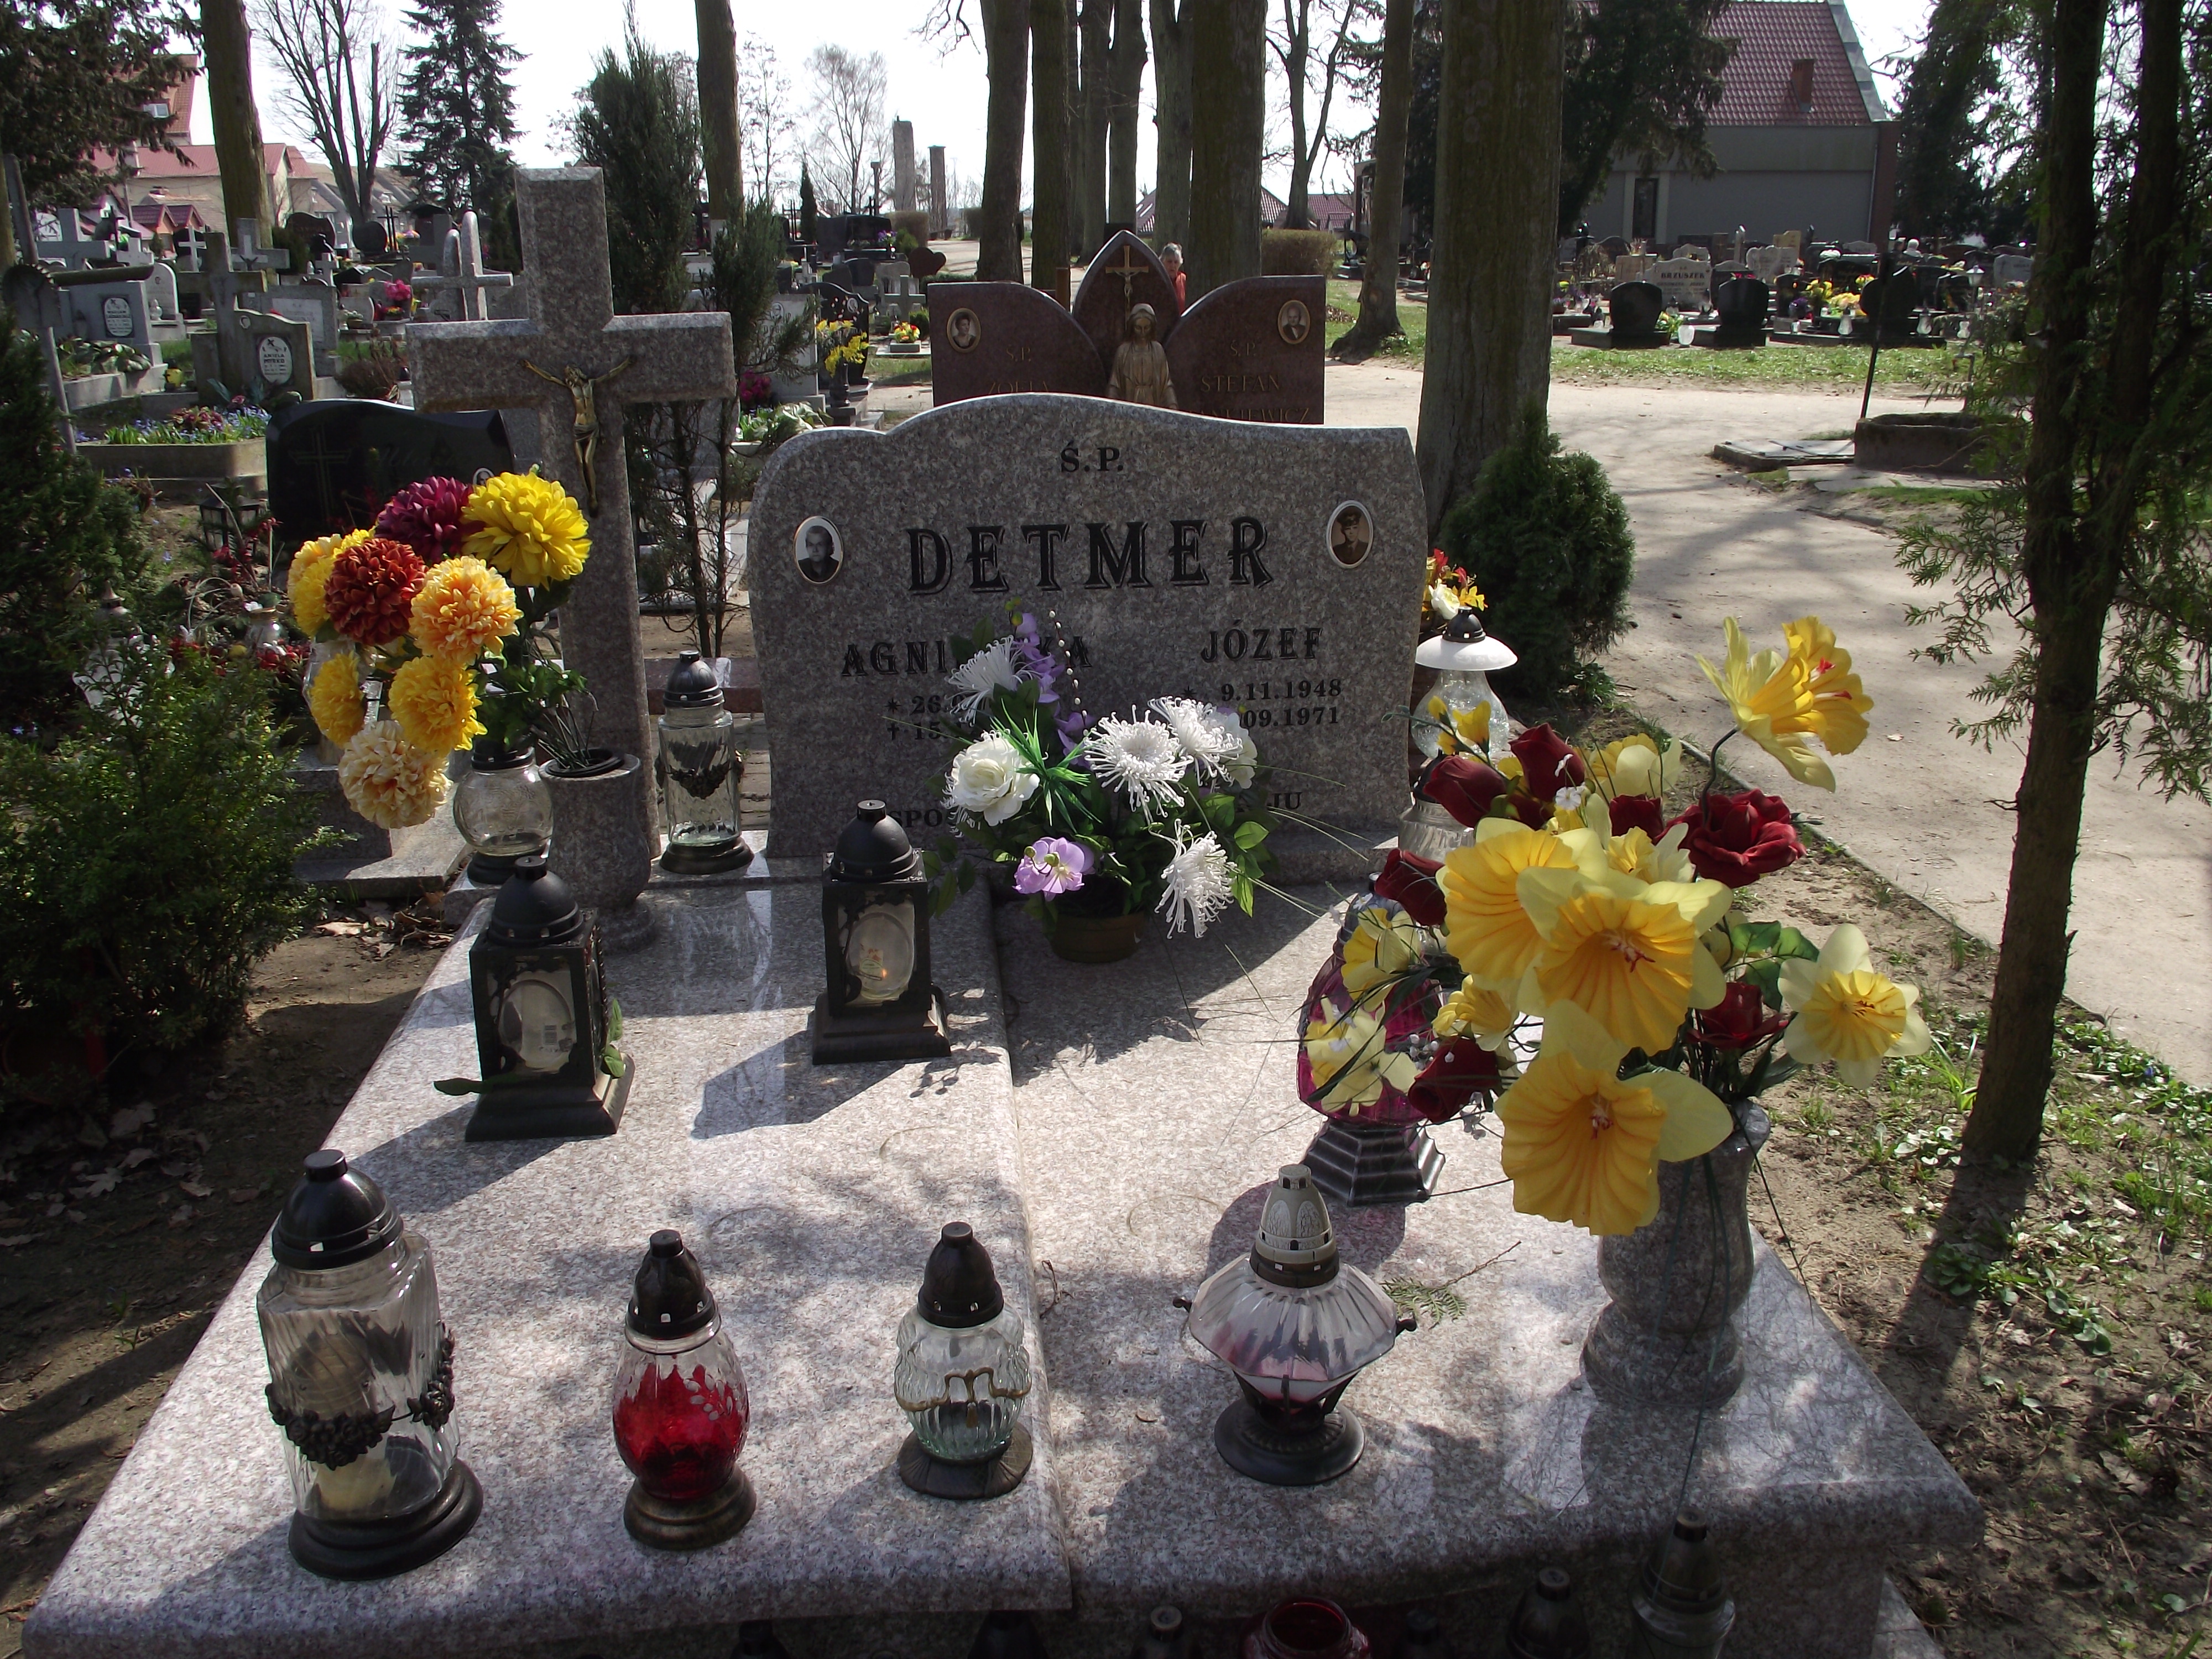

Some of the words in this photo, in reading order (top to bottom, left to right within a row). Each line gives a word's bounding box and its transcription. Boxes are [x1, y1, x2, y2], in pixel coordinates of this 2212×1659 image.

[1200, 374, 1280, 393] STEFAN
[1061, 441, 1124, 473] Ś.P.
[906, 515, 1273, 595] DETMER
[841, 636, 1092, 677] AGNIKA
[1201, 619, 1323, 663] JÓZEF
[1220, 679, 1342, 701] 9.11.1948
